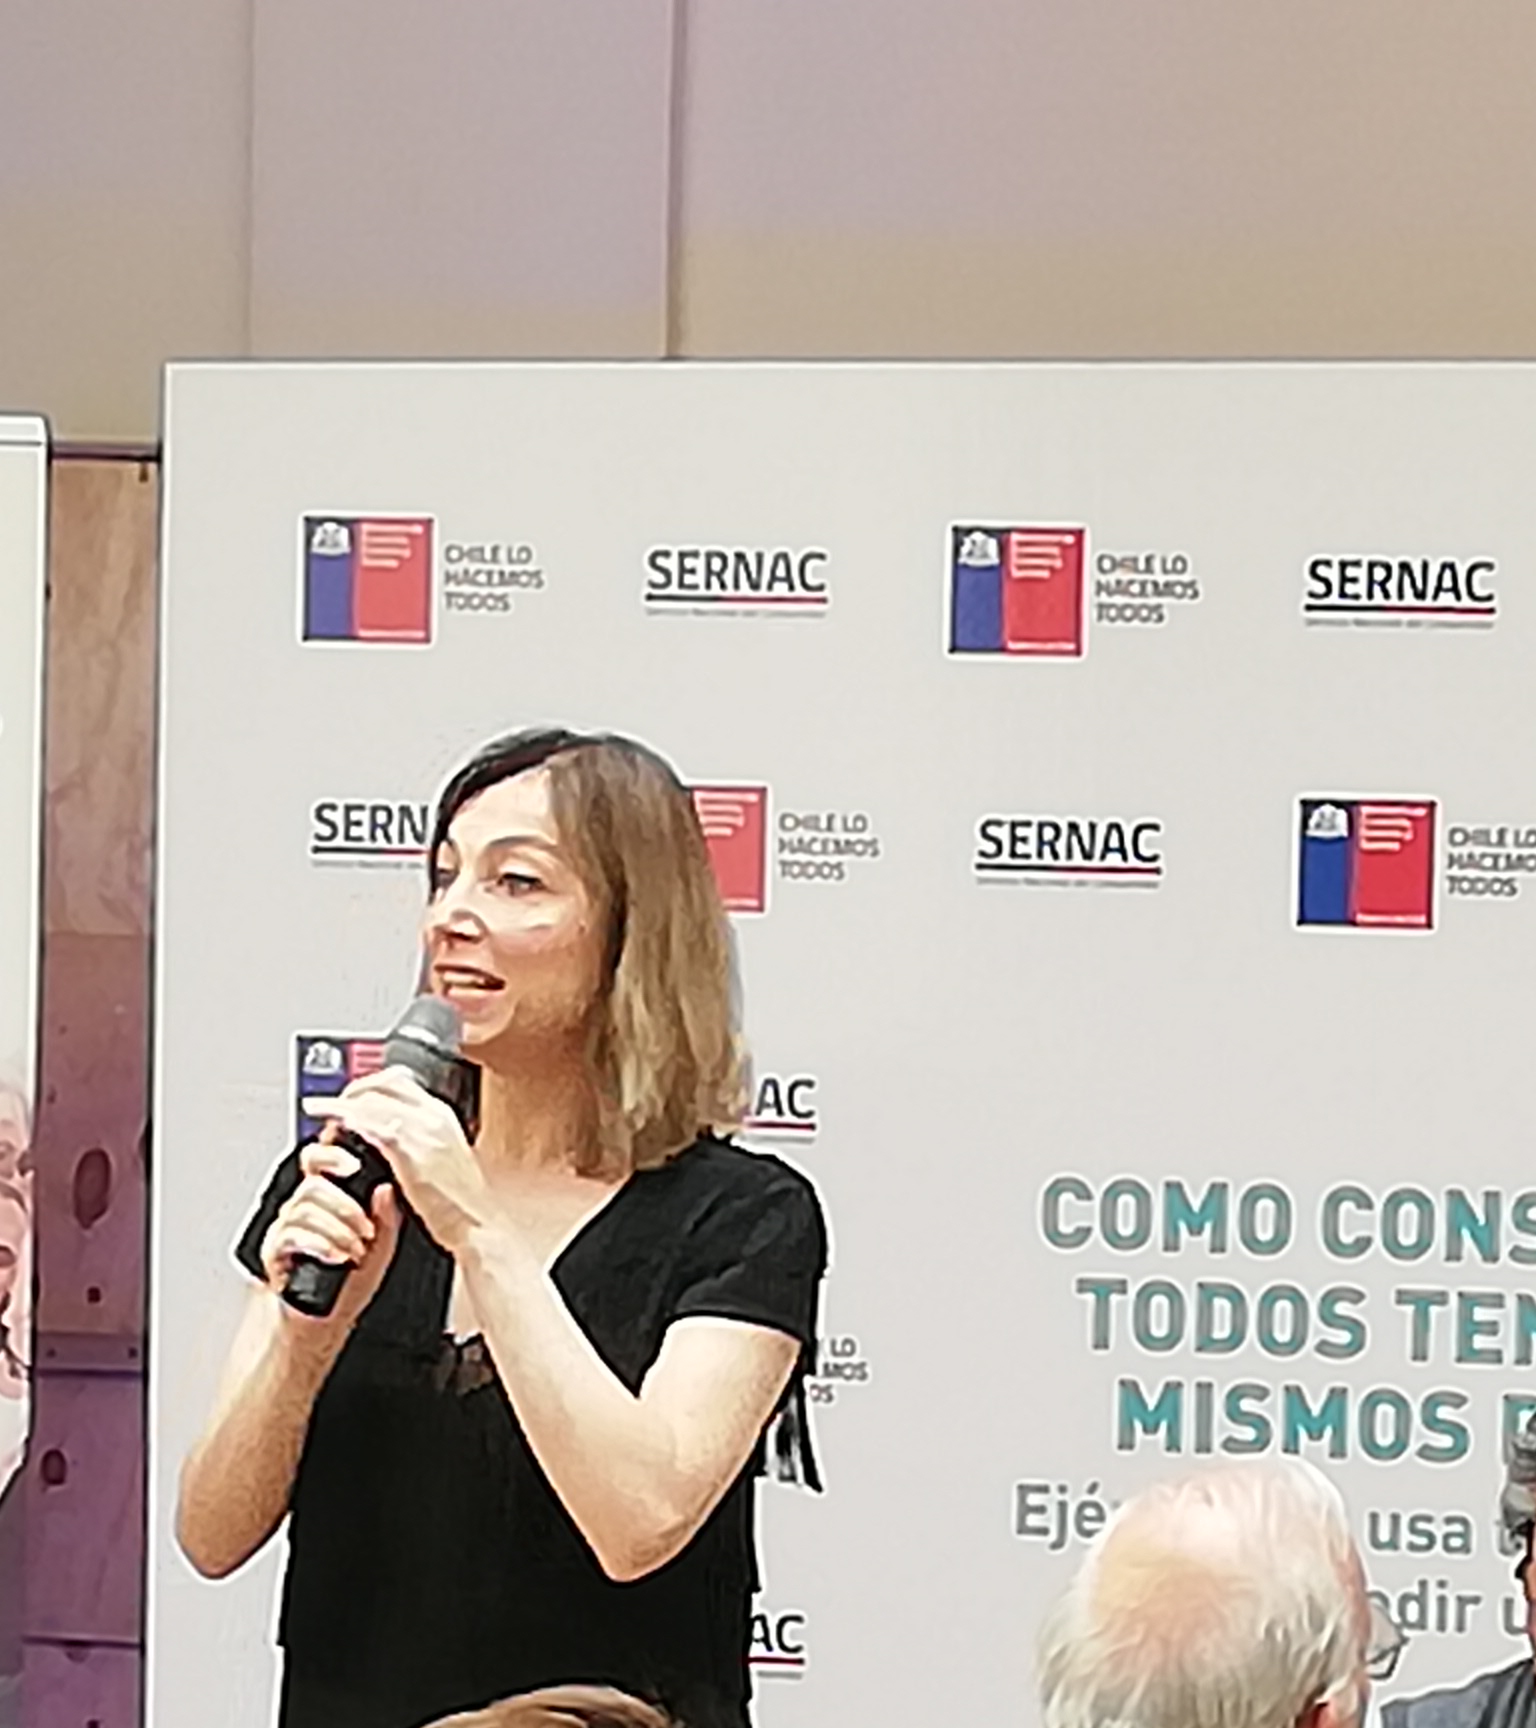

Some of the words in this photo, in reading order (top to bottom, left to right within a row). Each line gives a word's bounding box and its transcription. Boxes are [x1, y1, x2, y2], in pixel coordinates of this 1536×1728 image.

[647, 549, 827, 592] SERNAC
[1307, 559, 1495, 603] SERNAC
[312, 802, 428, 845] SERN
[977, 819, 1161, 863] SERNAC
[1042, 1177, 1291, 1255] COMO
[1076, 1278, 1366, 1359] TODOS
[1117, 1379, 1470, 1463] MISMOS
[1369, 1511, 1472, 1555] usa
